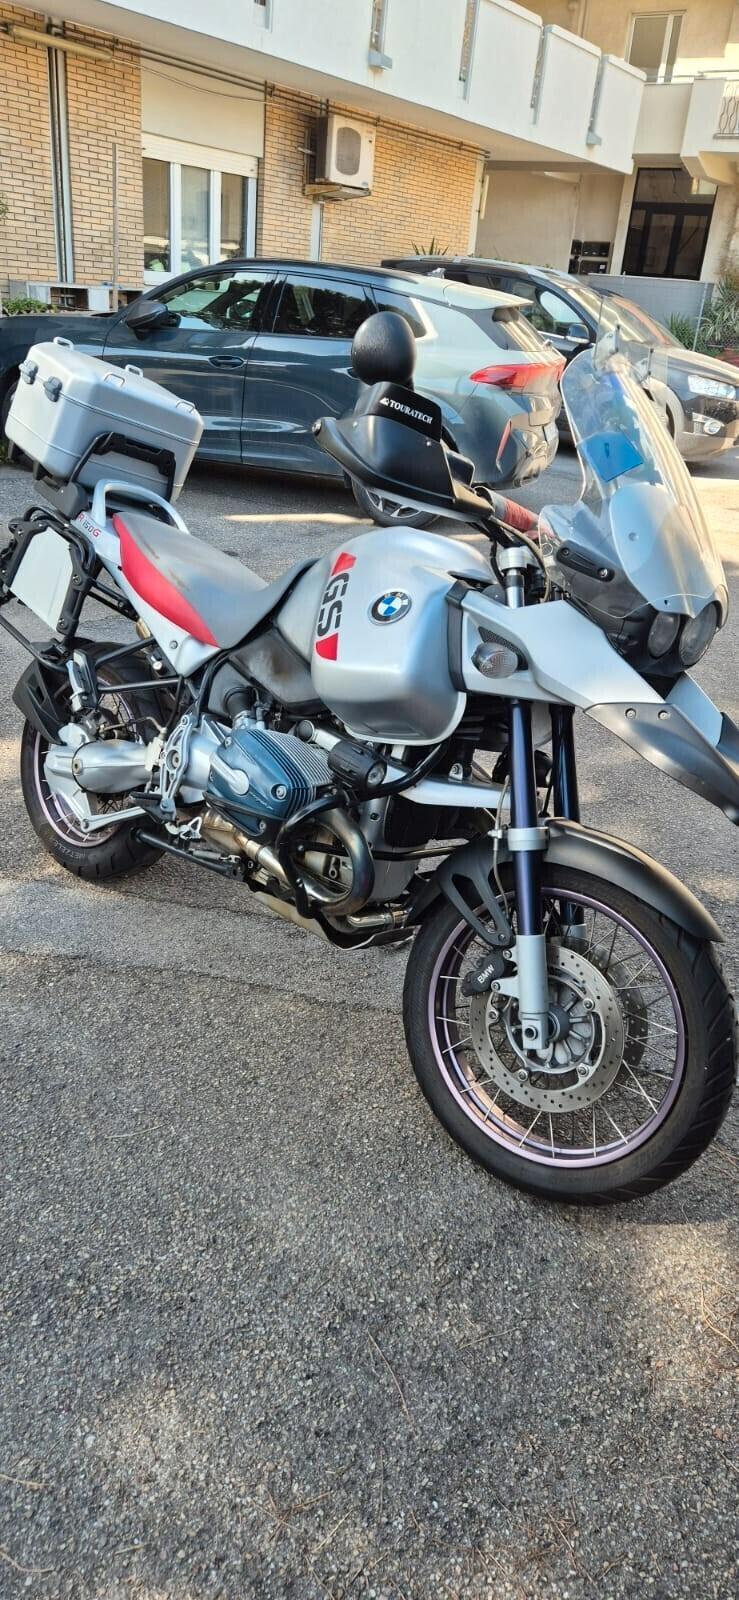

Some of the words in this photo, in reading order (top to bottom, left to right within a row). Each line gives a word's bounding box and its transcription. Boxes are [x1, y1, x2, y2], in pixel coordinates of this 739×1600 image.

[390, 400, 433, 424] TOURATECH
[317, 572, 350, 637] GS
[477, 964, 495, 984] BMW
